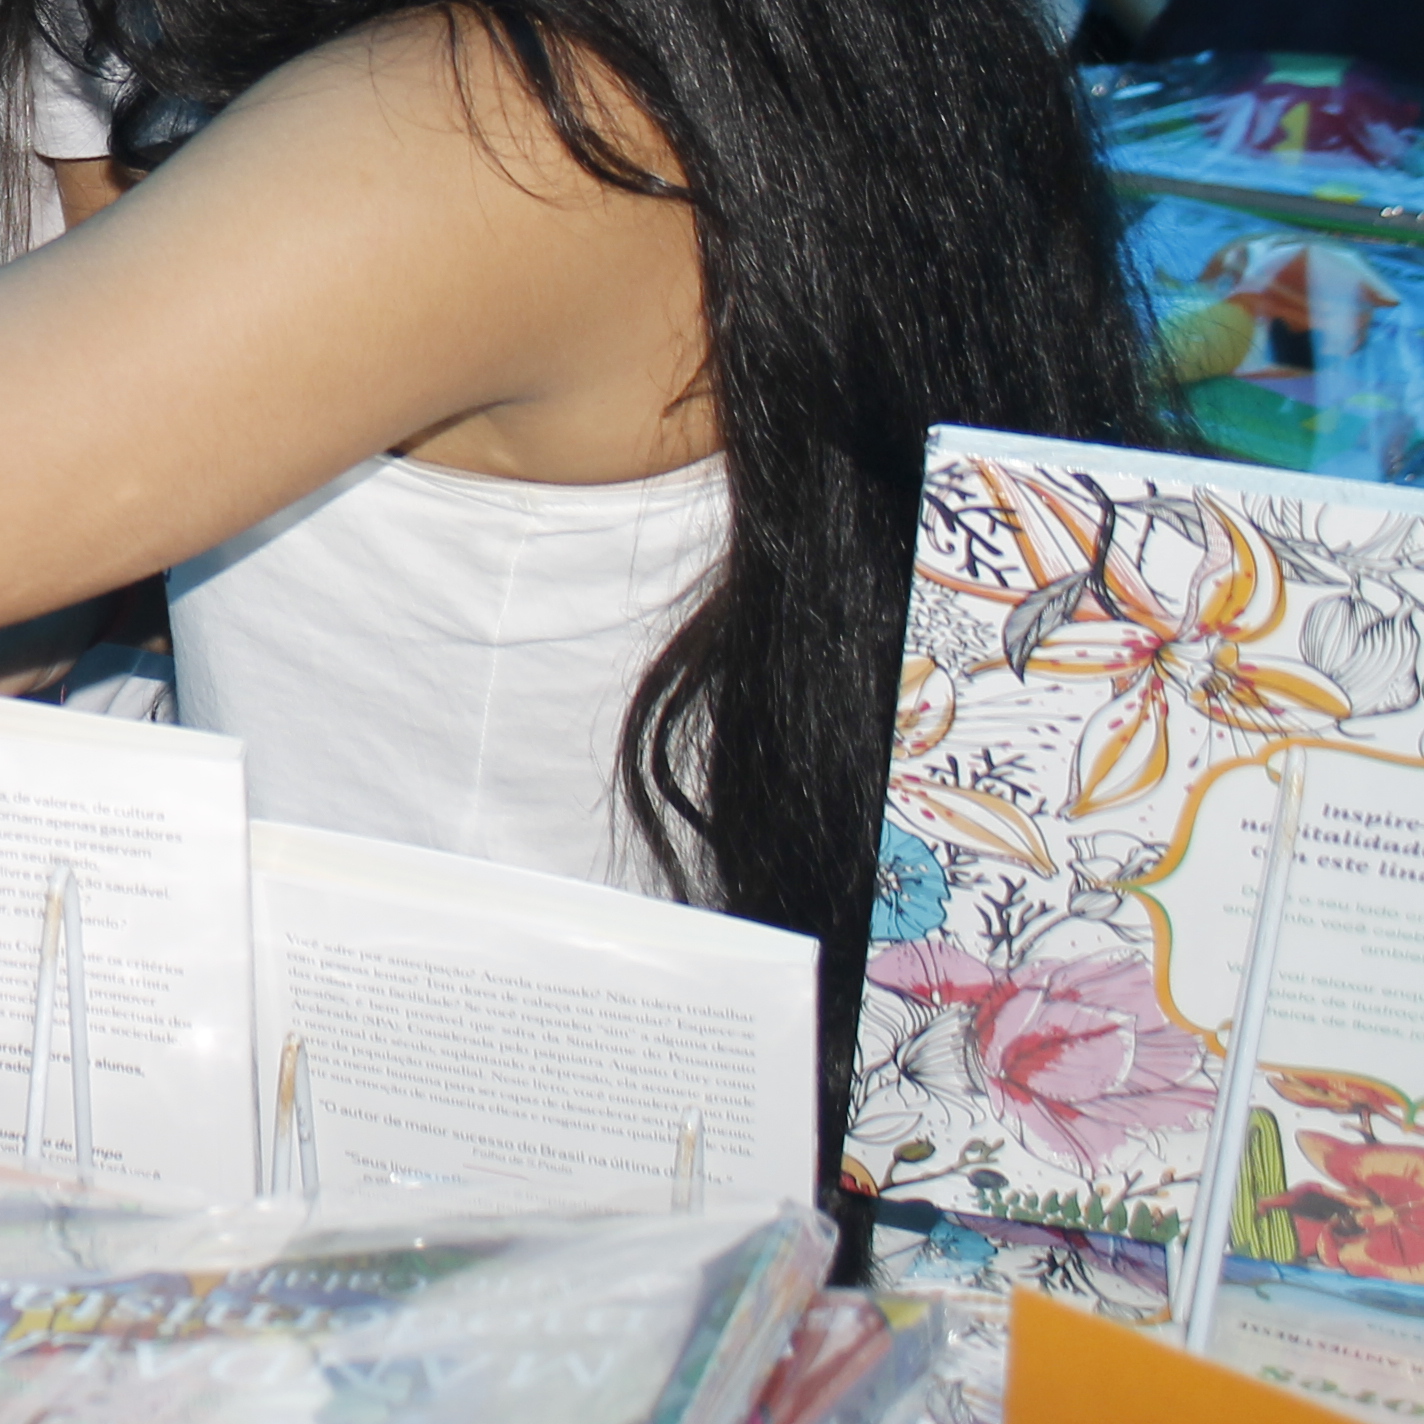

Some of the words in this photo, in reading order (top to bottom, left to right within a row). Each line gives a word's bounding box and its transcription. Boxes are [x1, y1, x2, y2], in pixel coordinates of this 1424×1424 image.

[113, 802, 165, 825] cultura
[1317, 854, 1369, 874] este
[93, 1055, 145, 1077] alunos,
